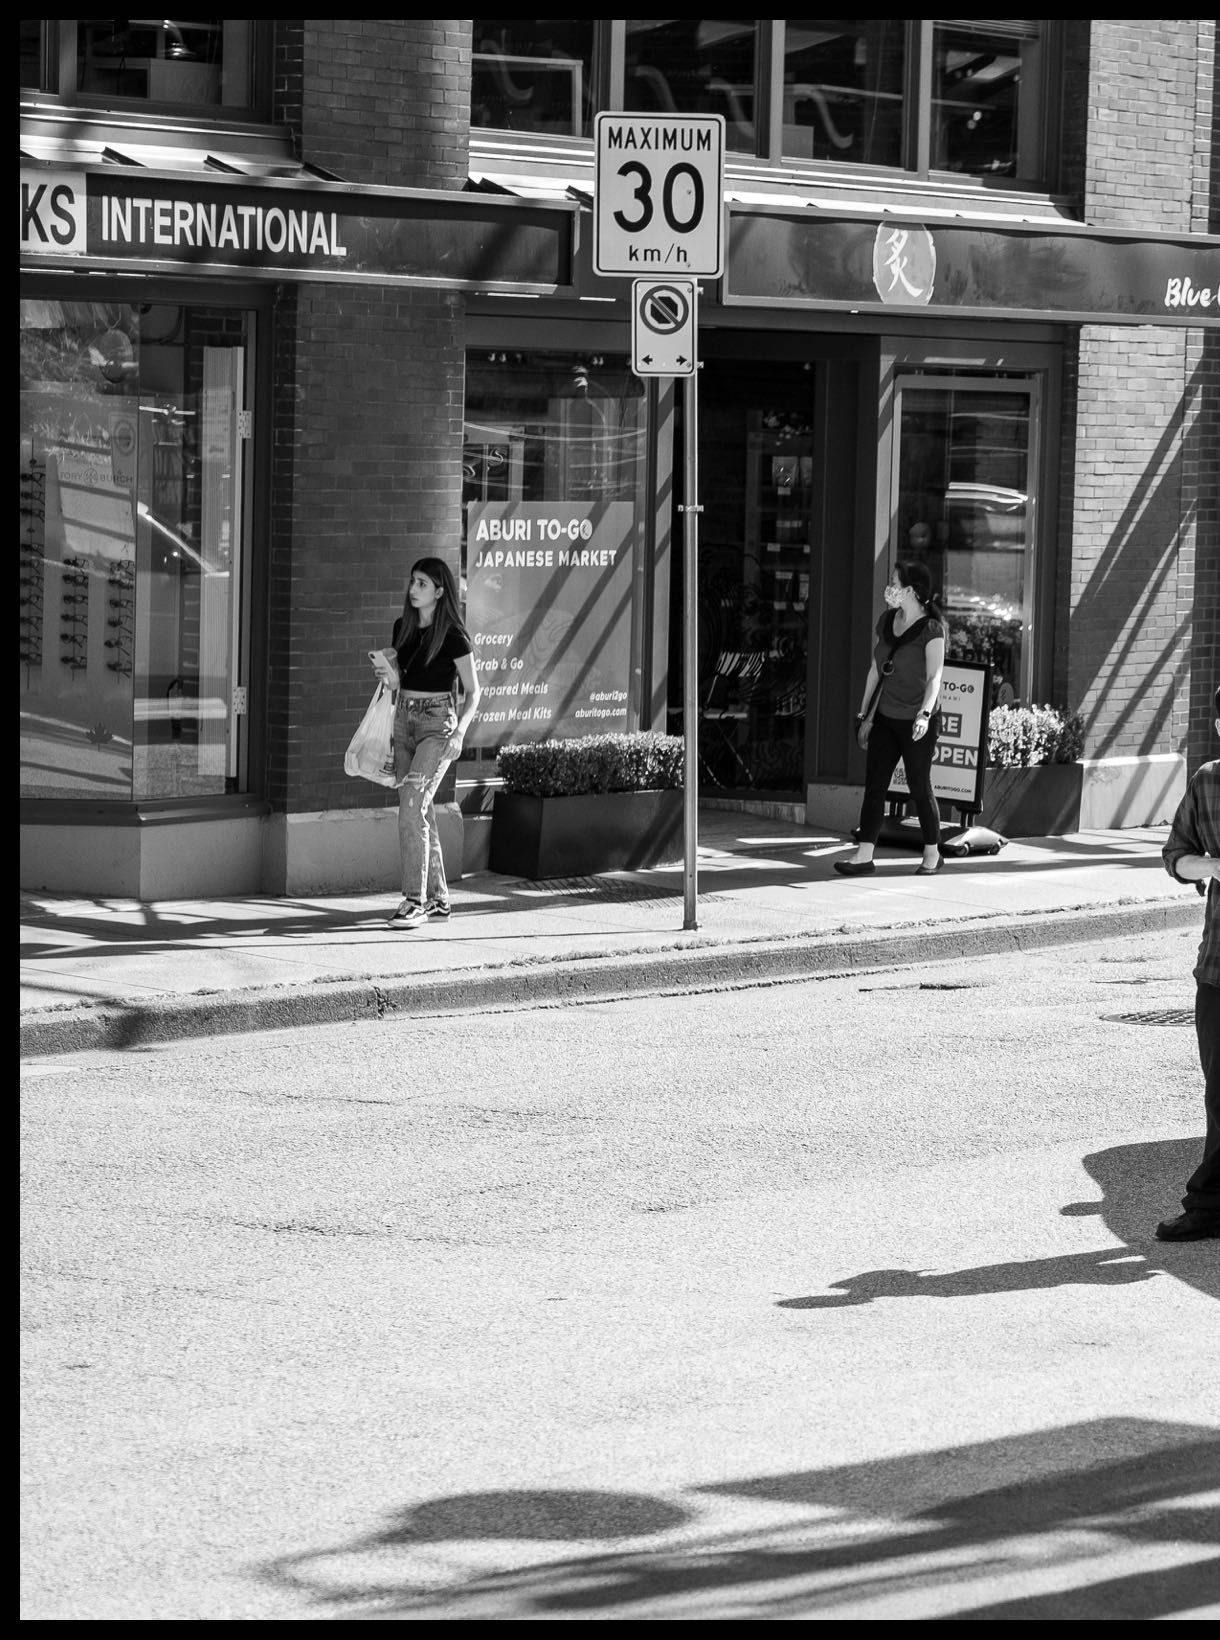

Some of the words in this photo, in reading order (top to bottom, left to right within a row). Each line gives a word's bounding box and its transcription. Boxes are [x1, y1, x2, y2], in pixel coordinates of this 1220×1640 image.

[608, 126, 712, 151] MAXIMUM
[613, 160, 704, 234] 30
[101, 195, 347, 256] INTERNATIONAL
[629, 243, 688, 264] km/h
[1164, 277, 1212, 308] Blue
[59, 472, 83, 481] TORY
[99, 473, 133, 483] BURCH
[475, 519, 531, 541] ABURI
[537, 519, 593, 541] TO-GO
[475, 551, 553, 568] JAPANESE
[558, 550, 617, 567] MARKET
[474, 632, 513, 647] Grocery
[474, 658, 498, 671] Grab
[500, 658, 507, 669] &
[510, 657, 524, 670] Go
[479, 682, 519, 699] repared
[521, 681, 548, 695] Meals
[589, 690, 628, 703] @aburi2go
[943, 681, 975, 694] TO-GO
[472, 710, 506, 723] Frozen
[508, 707, 531, 721] Meal
[533, 706, 552, 720] Kits
[575, 707, 627, 719] aburitogo.com
